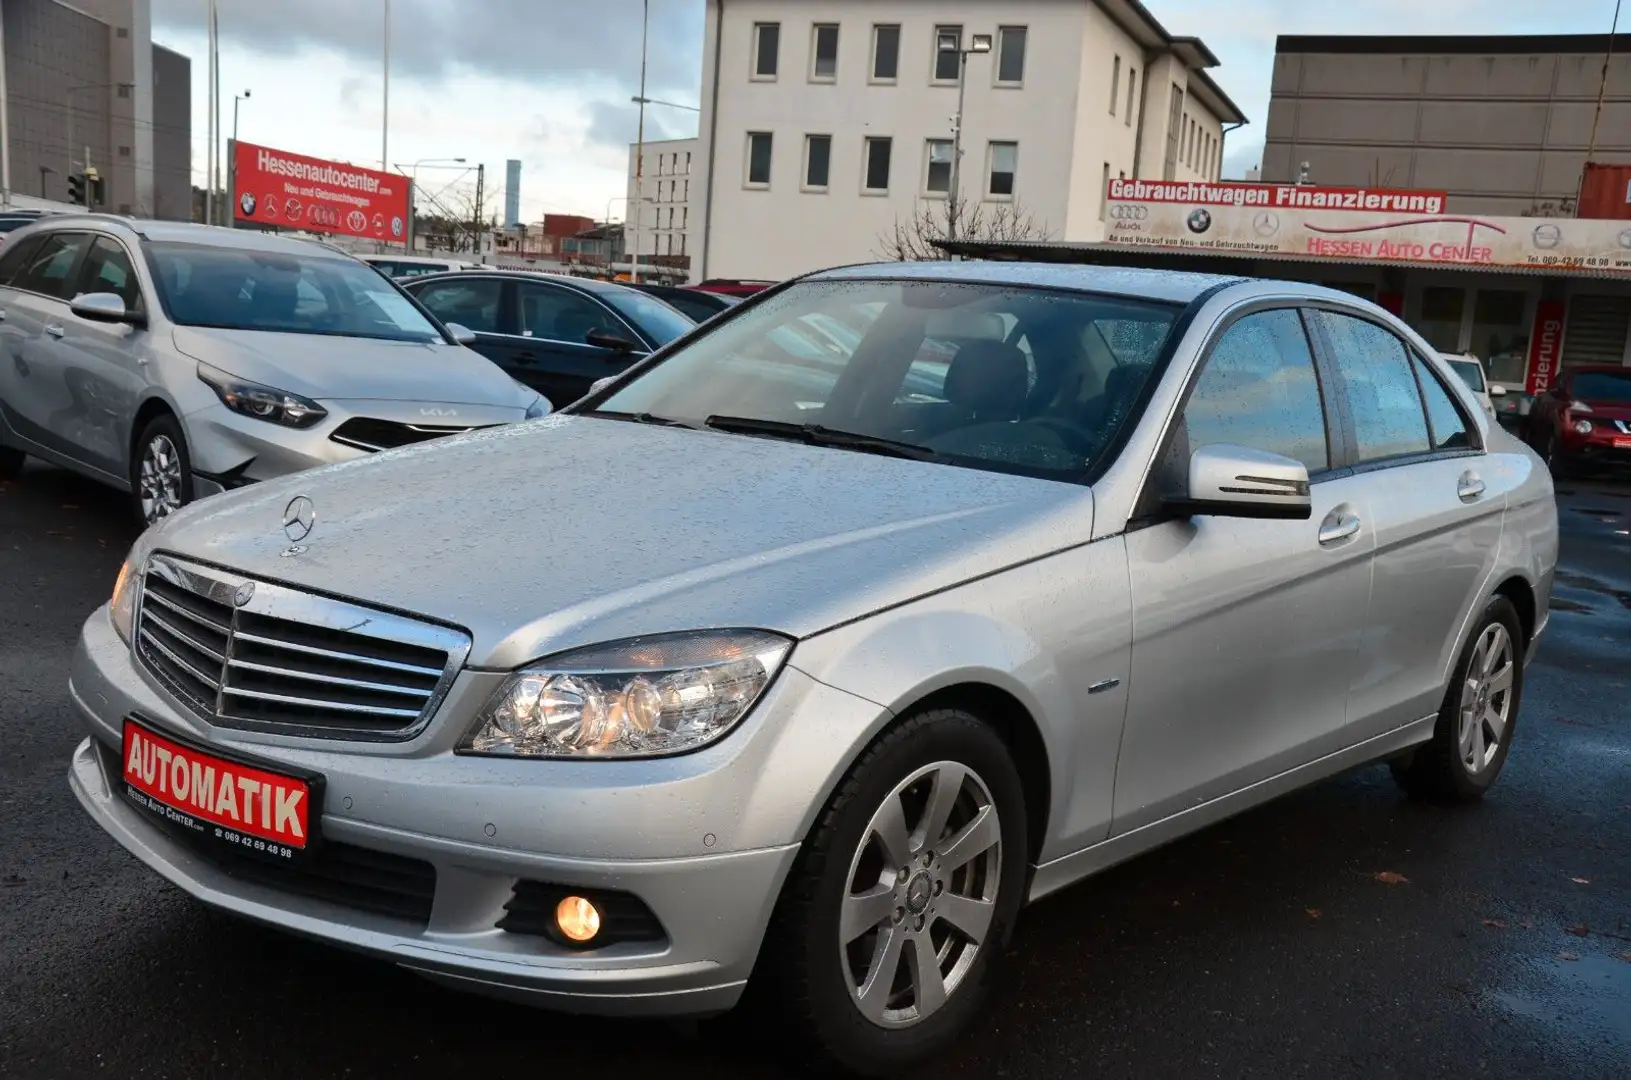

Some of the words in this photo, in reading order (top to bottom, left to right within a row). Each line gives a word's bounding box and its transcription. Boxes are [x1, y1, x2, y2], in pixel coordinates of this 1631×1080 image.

[1111, 179, 1269, 206] Gebrauchtwagen
[1276, 187, 1441, 213] Finanzierung
[1135, 236, 1163, 245] Verkauf
[1216, 240, 1279, 252] Gebrauchtwagen
[1528, 255, 1541, 263] Tel.
[127, 732, 305, 838] AUTOMATIK
[224, 831, 240, 843] 069
[241, 837, 253, 847] 42
[254, 840, 266, 851] 69
[267, 844, 279, 855] 48
[280, 847, 293, 859] 98
